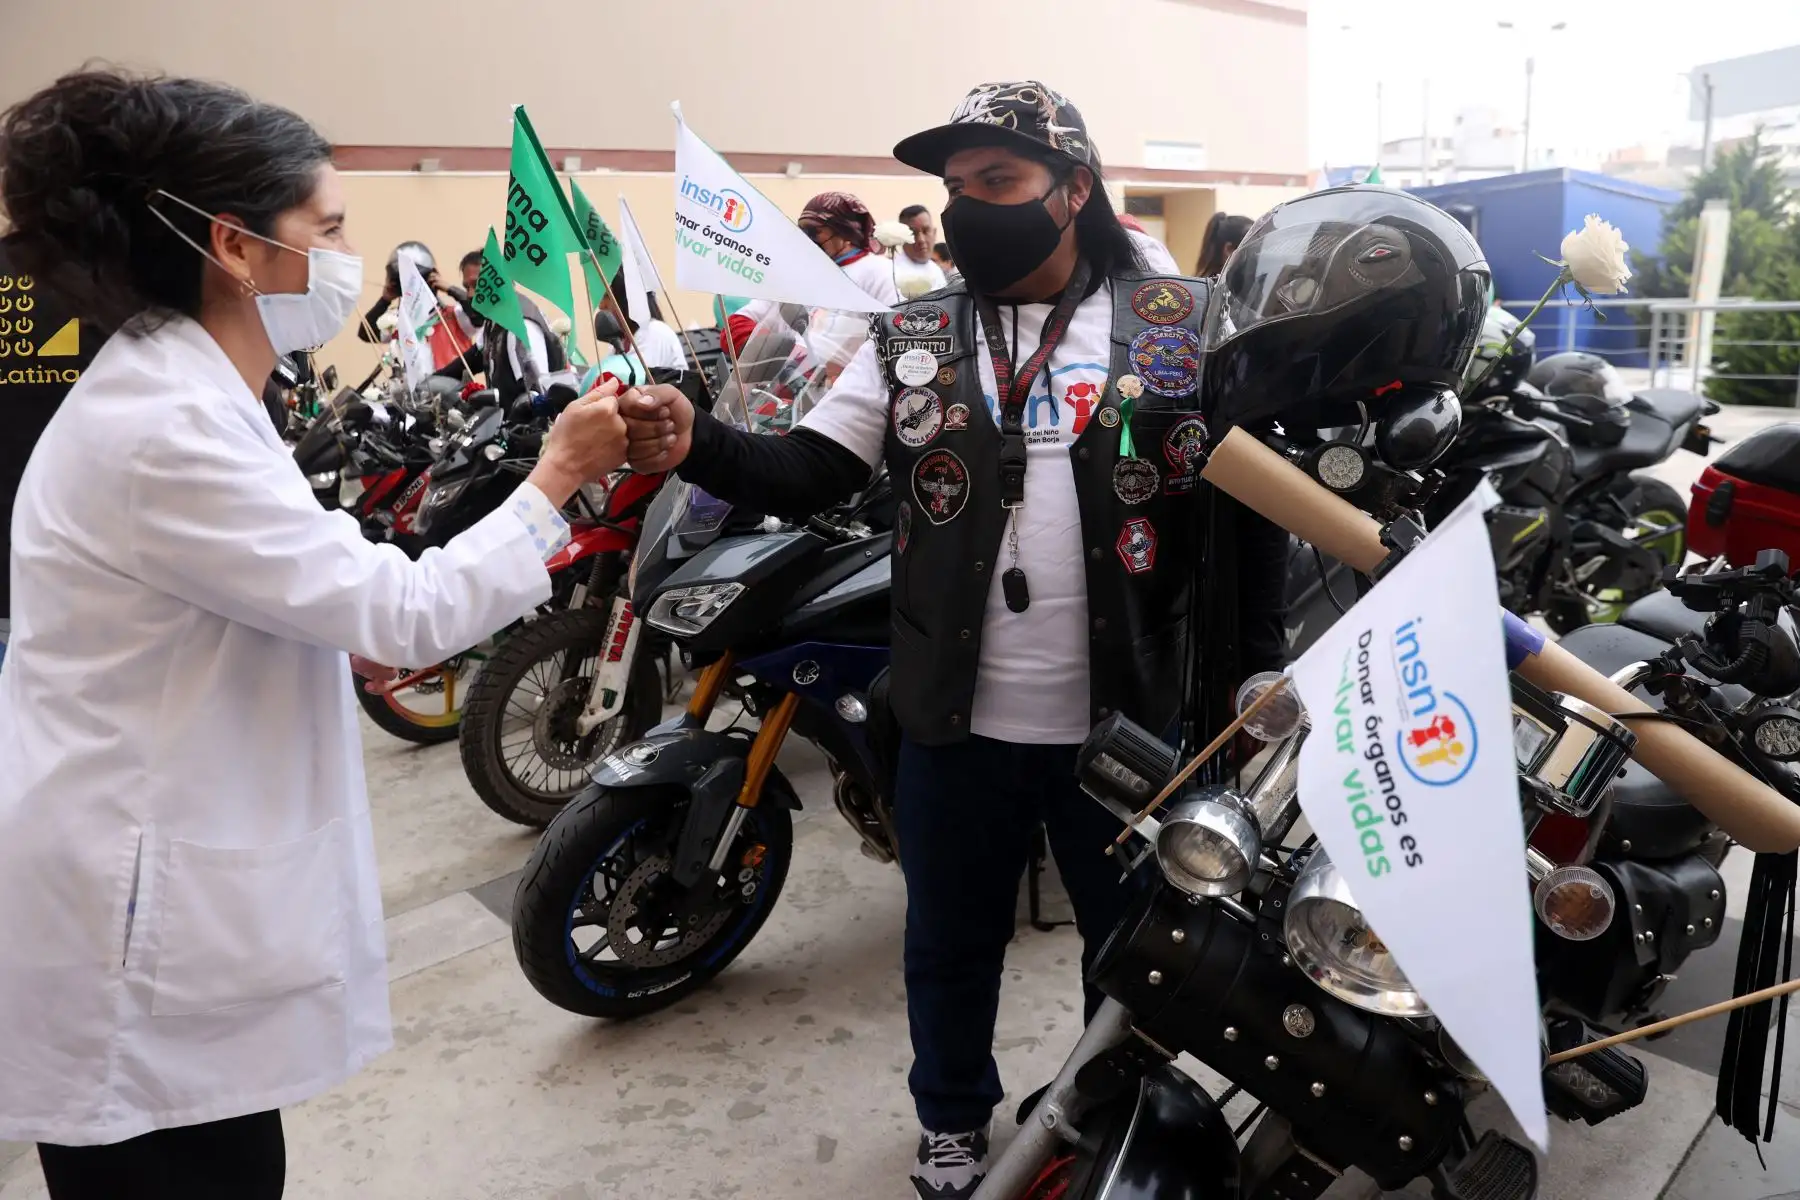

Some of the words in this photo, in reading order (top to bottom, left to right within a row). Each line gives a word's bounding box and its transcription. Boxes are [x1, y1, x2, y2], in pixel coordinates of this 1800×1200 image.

[681, 175, 724, 210] insn
[702, 225, 753, 257] órganos
[756, 253, 771, 266] es
[717, 252, 765, 284] vidas
[892, 341, 946, 353] JUANCITO
[1042, 436, 1060, 444] Borja
[399, 477, 425, 505] IPONE
[1358, 629, 1377, 706] Donar
[1396, 616, 1438, 717] insn
[603, 754, 633, 782] YAMAHA
[1364, 714, 1408, 827] órganos
[1343, 768, 1391, 878] vidas
[1400, 835, 1423, 869] es
